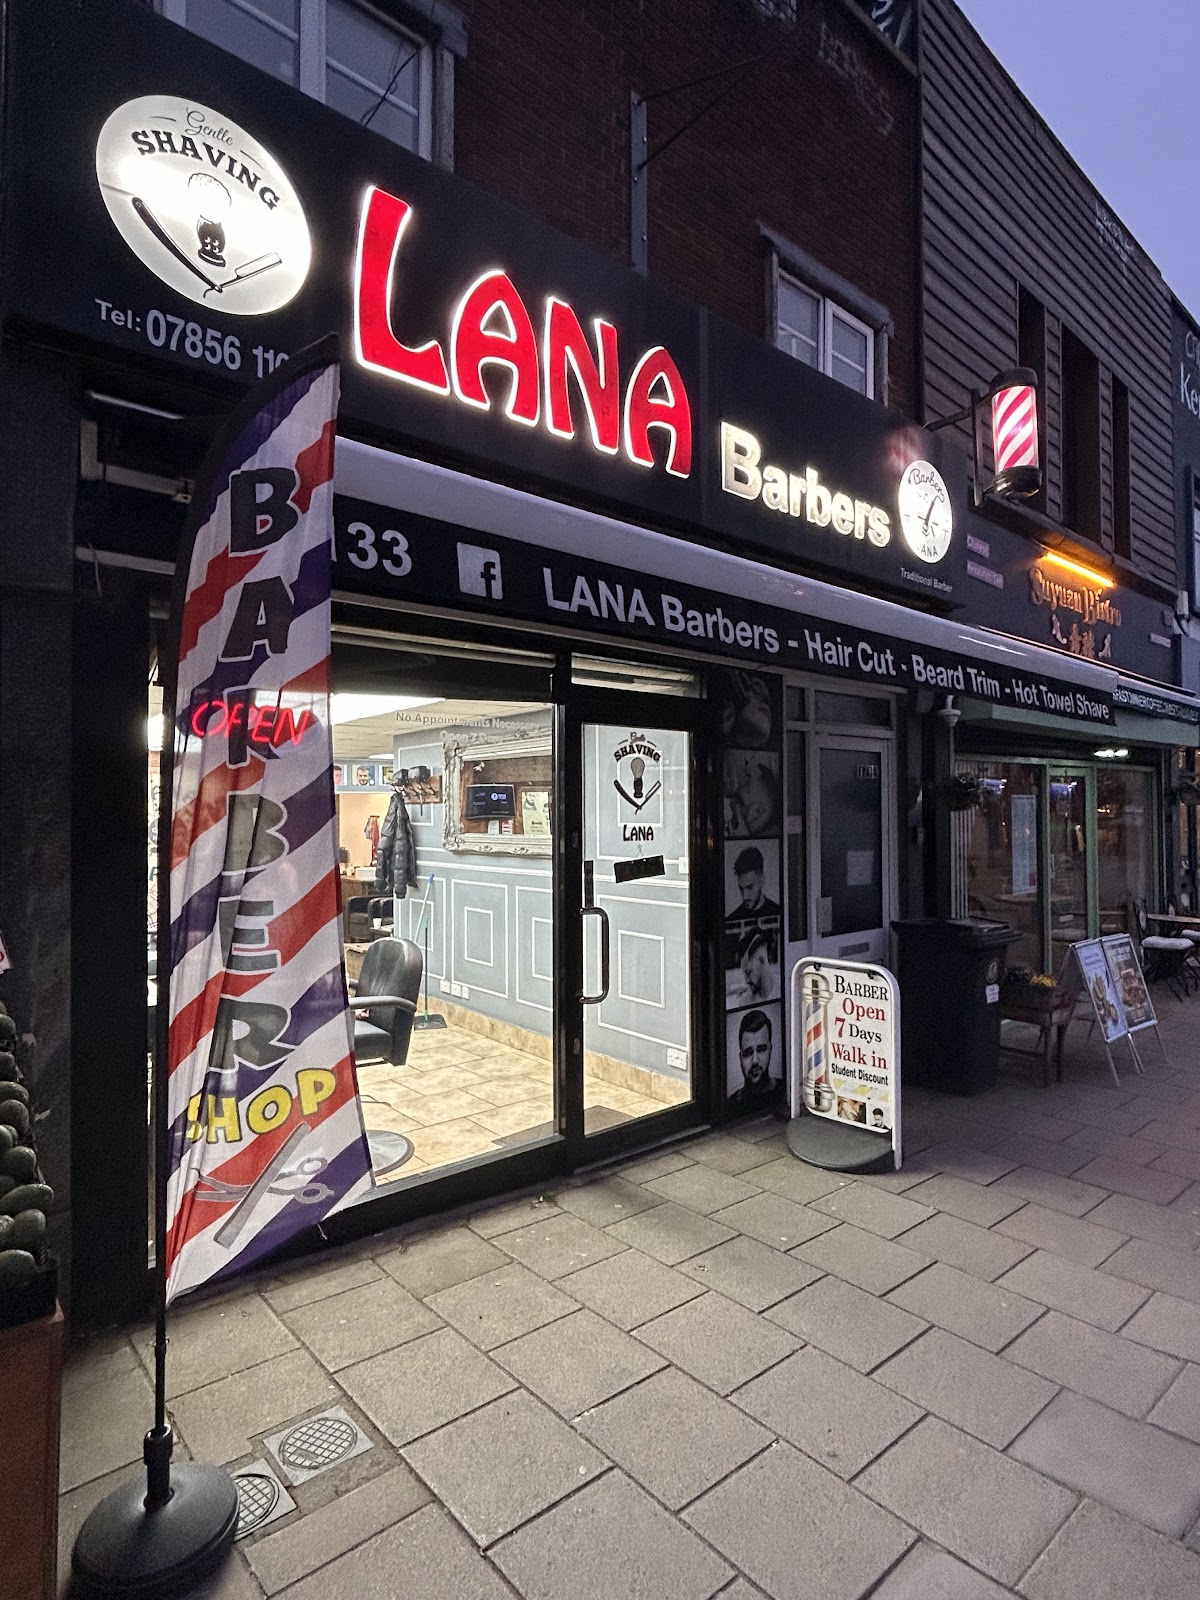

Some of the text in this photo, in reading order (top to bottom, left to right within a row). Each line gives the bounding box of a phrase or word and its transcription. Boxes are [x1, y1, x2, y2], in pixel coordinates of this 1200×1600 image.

[184, 107, 234, 146] Gentle
[131, 129, 281, 211] SHAVING
[95, 298, 141, 333] Tel:
[146, 309, 242, 371] 07856
[353, 184, 693, 479] LANA
[720, 421, 891, 548] Barbers
[900, 567, 953, 593] Traditional Barber
[543, 567, 656, 626] LANA
[660, 593, 780, 654] Barbers
[803, 628, 853, 668] Hair
[857, 641, 897, 676] Cut
[911, 653, 965, 690] Beard
[966, 666, 1001, 699] Trim
[1011, 678, 1040, 706] Hot
[1039, 684, 1075, 713] Towel
[1075, 693, 1110, 720] Shave
[191, 699, 312, 746] OPEN
[396, 712, 411, 722] No
[415, 713, 491, 728] Appointments
[613, 744, 662, 764] SHAVING
[623, 824, 654, 842] LANA
[834, 974, 889, 1001] BARBER
[842, 997, 886, 1022] Open
[834, 1016, 882, 1044] 7 Days
[831, 1042, 888, 1070] Walk in
[831, 1062, 889, 1086] Student Discount
[186, 1067, 337, 1144] SHOP
